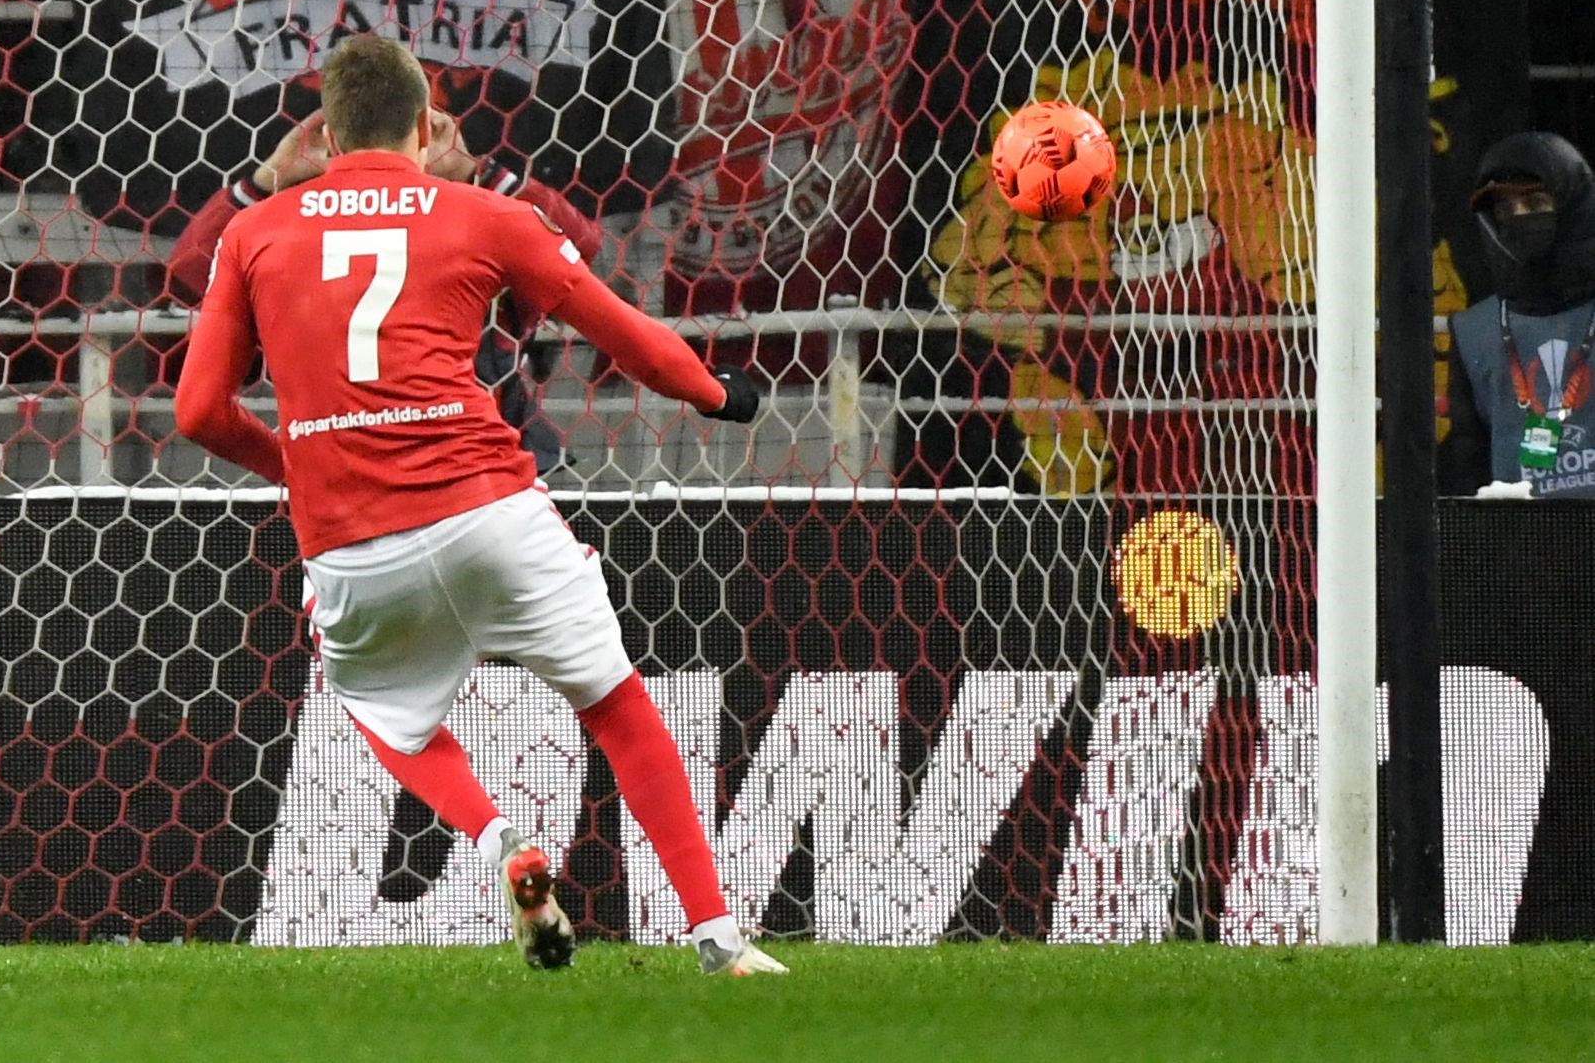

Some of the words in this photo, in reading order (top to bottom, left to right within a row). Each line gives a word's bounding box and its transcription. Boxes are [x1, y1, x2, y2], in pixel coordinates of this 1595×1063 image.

[299, 186, 438, 217] SOBOLEV
[321, 227, 408, 383] 7
[1539, 472, 1595, 494] LEAGUE
